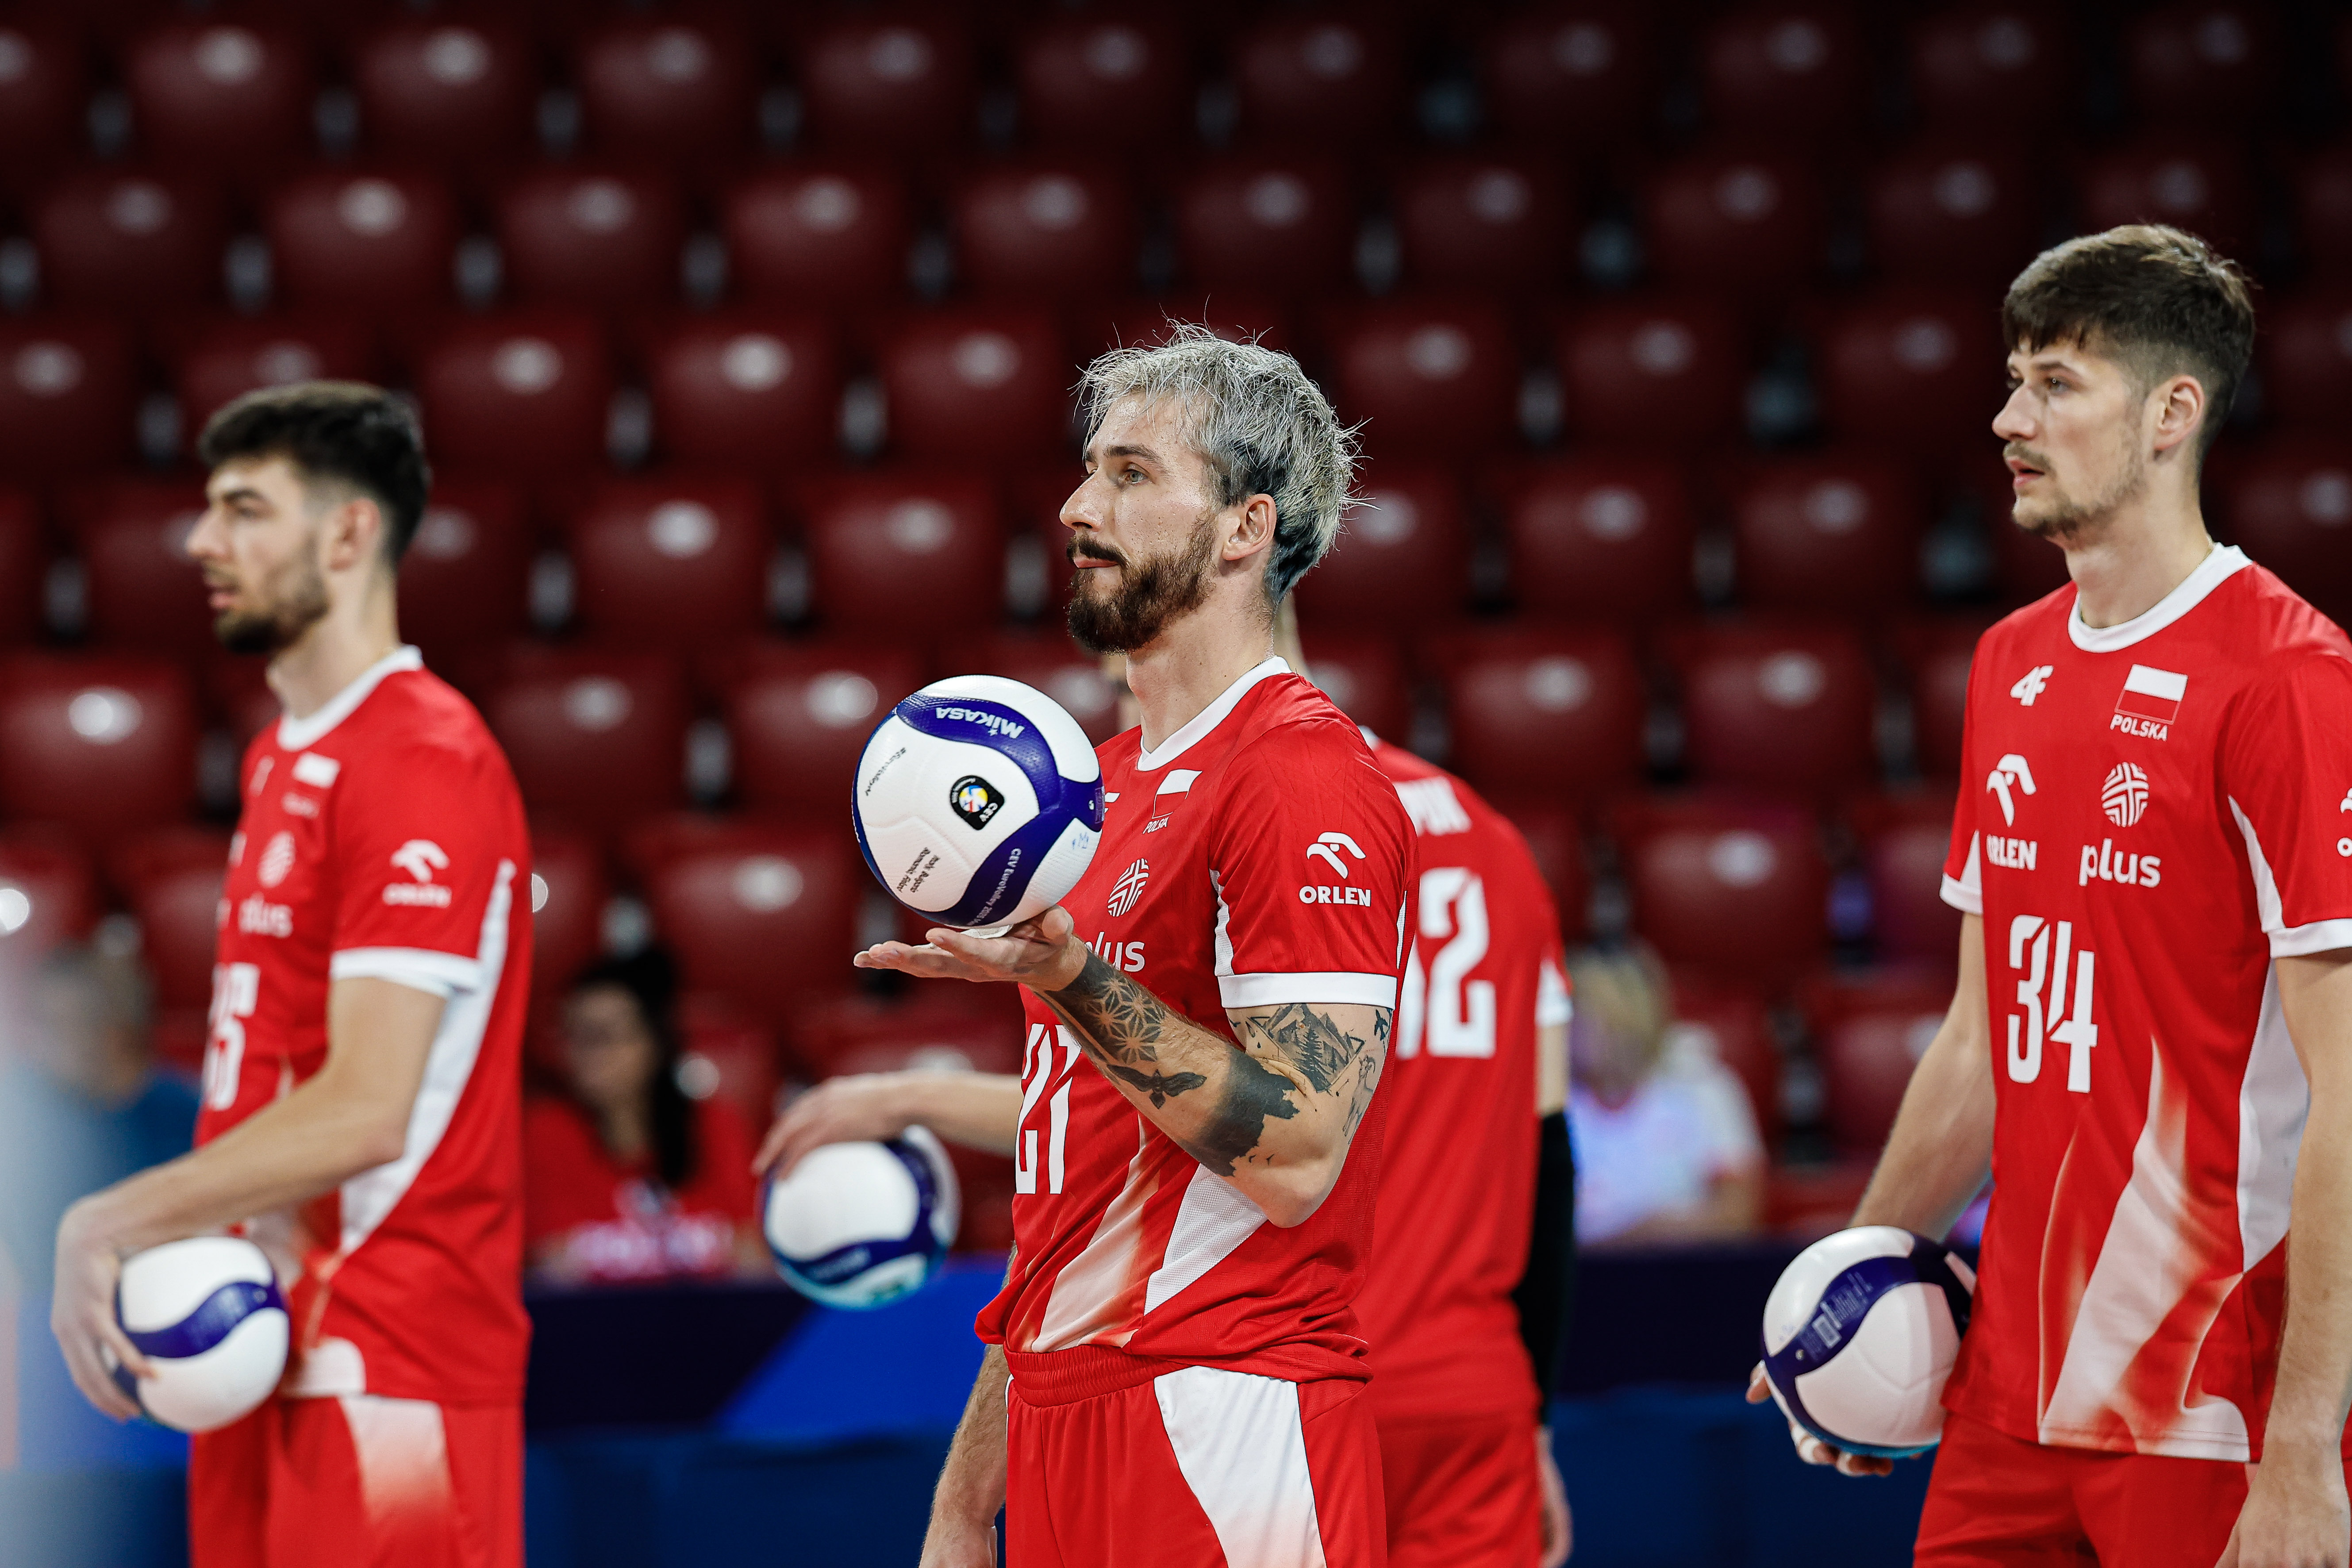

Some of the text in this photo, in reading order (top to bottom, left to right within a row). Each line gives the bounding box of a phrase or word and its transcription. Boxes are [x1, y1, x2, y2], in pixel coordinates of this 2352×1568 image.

[2010, 665, 2054, 707] 4F
[2110, 713, 2168, 742] POLSKA
[2079, 838, 2162, 888] plus
[1299, 886, 1372, 907] ORLEN
[1084, 931, 1145, 972] lus
[2007, 914, 2098, 1094] 34
